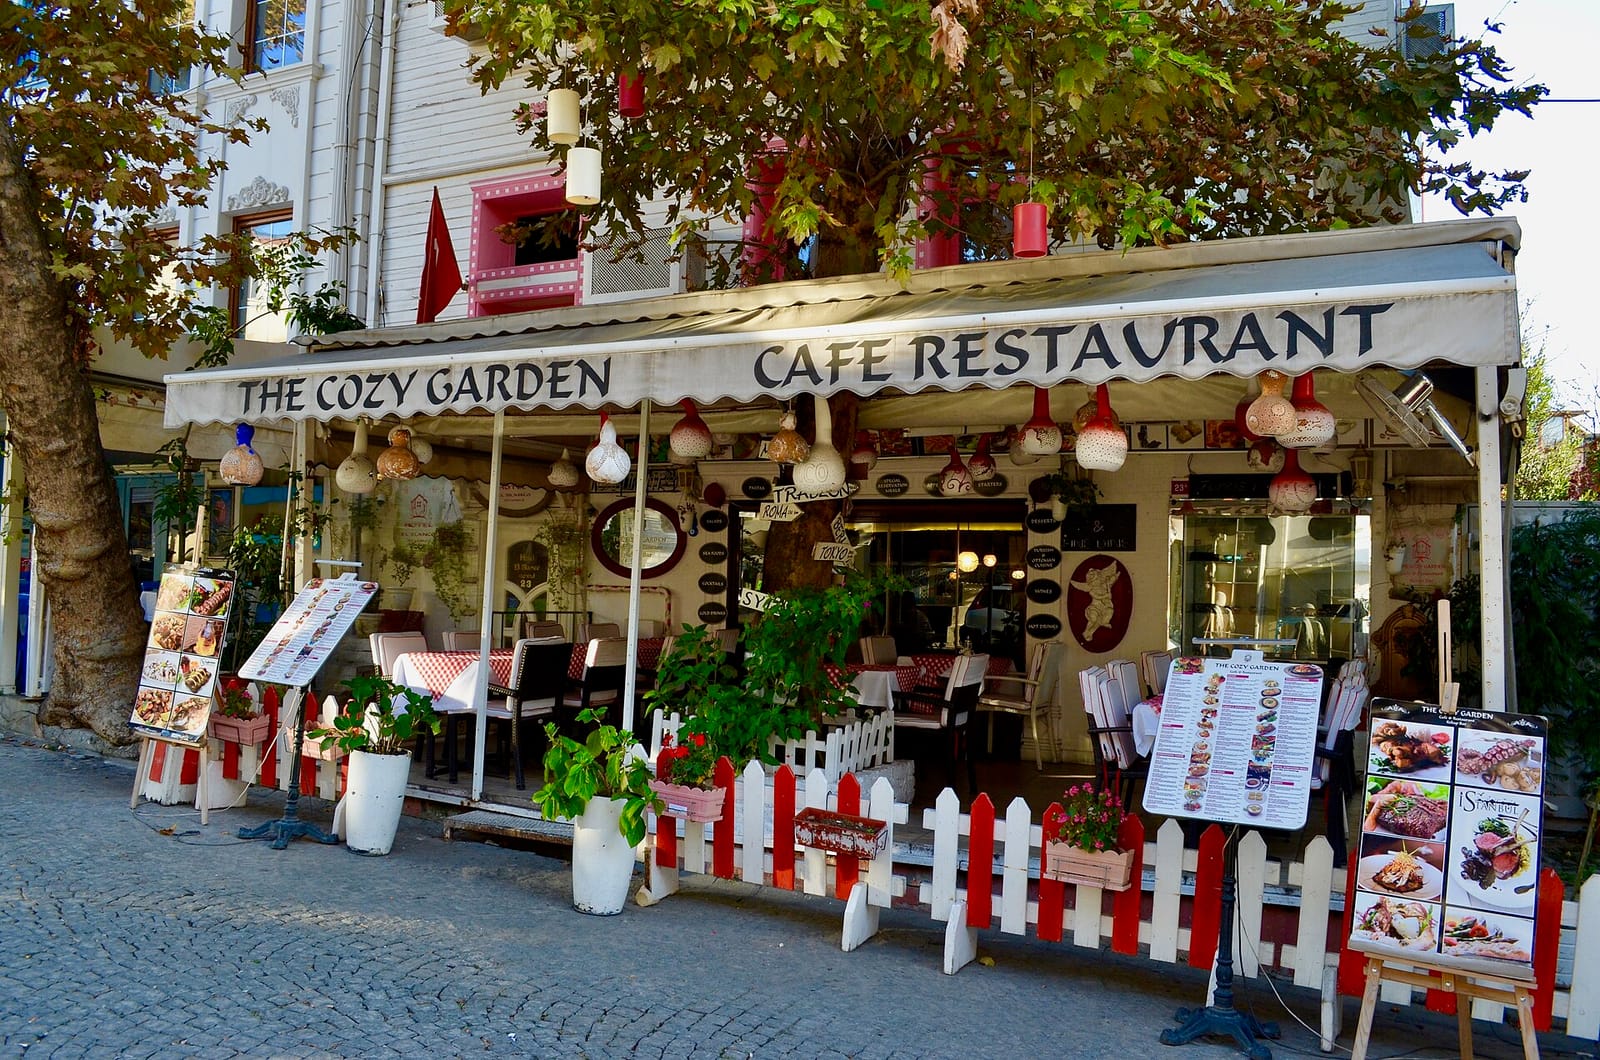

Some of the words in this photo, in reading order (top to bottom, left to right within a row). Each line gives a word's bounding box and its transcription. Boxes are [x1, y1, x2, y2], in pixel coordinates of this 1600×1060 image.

[753, 339, 892, 389] CAFE
[908, 302, 1395, 381] RESTAURANT
[238, 377, 308, 415] THE
[316, 369, 420, 411] COZY
[426, 356, 613, 405] GARDEN
[763, 505, 787, 519] ROMA
[820, 546, 849, 560] TOKYO
[520, 579, 532, 588] 23
[1421, 705, 1438, 714] THE
[1460, 709, 1495, 720] GARDEN
